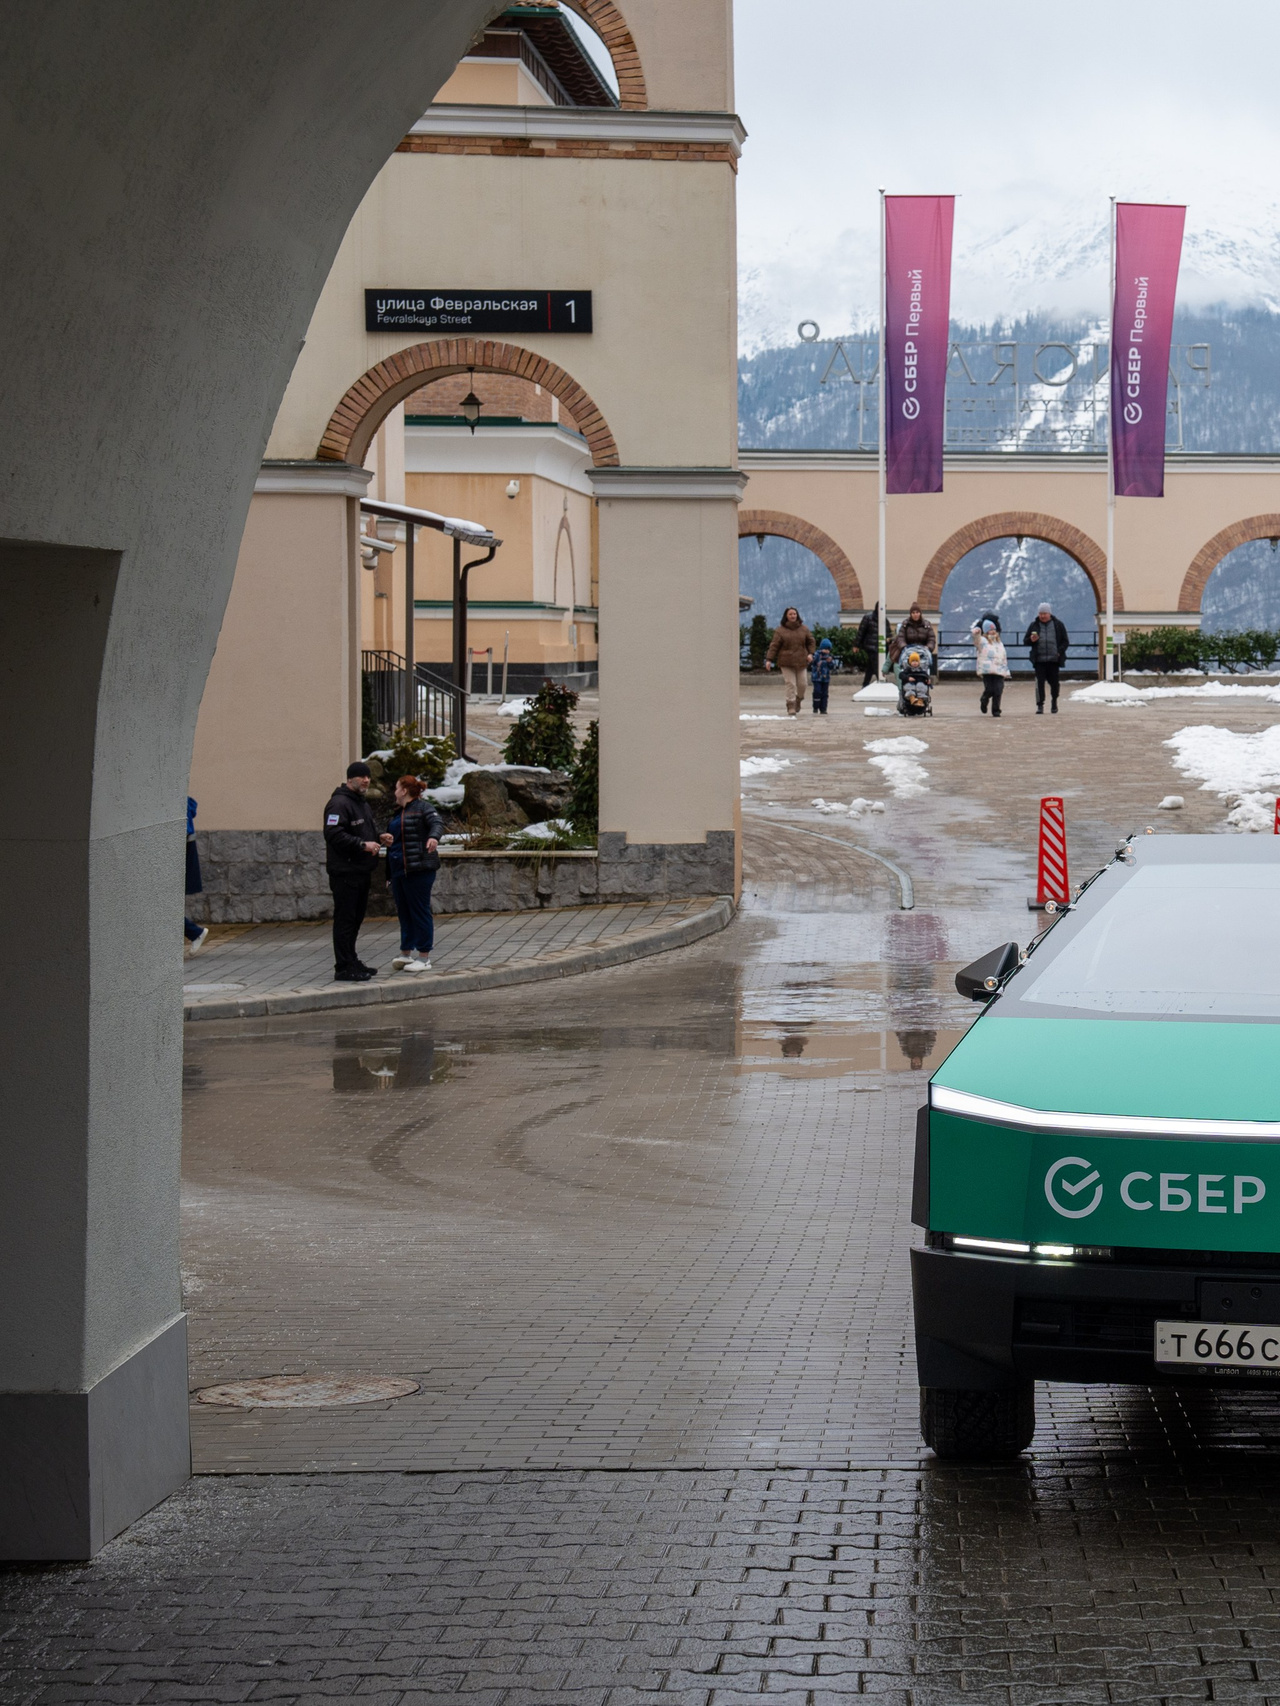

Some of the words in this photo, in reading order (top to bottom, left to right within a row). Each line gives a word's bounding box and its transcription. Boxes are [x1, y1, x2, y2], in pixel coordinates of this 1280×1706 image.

[376, 298, 425, 314] улица
[430, 296, 538, 313] Февральская
[377, 314, 438, 326] Fevralskaya
[440, 314, 472, 325] Street
[565, 299, 576, 324] 1
[905, 269, 923, 336] Первый
[1130, 276, 1149, 342] Первый
[904, 341, 918, 392] СБЕР
[1127, 347, 1141, 398] СБЕР
[1120, 1171, 1266, 1214] СБЕР
[1214, 1366, 1240, 1375] Larson
